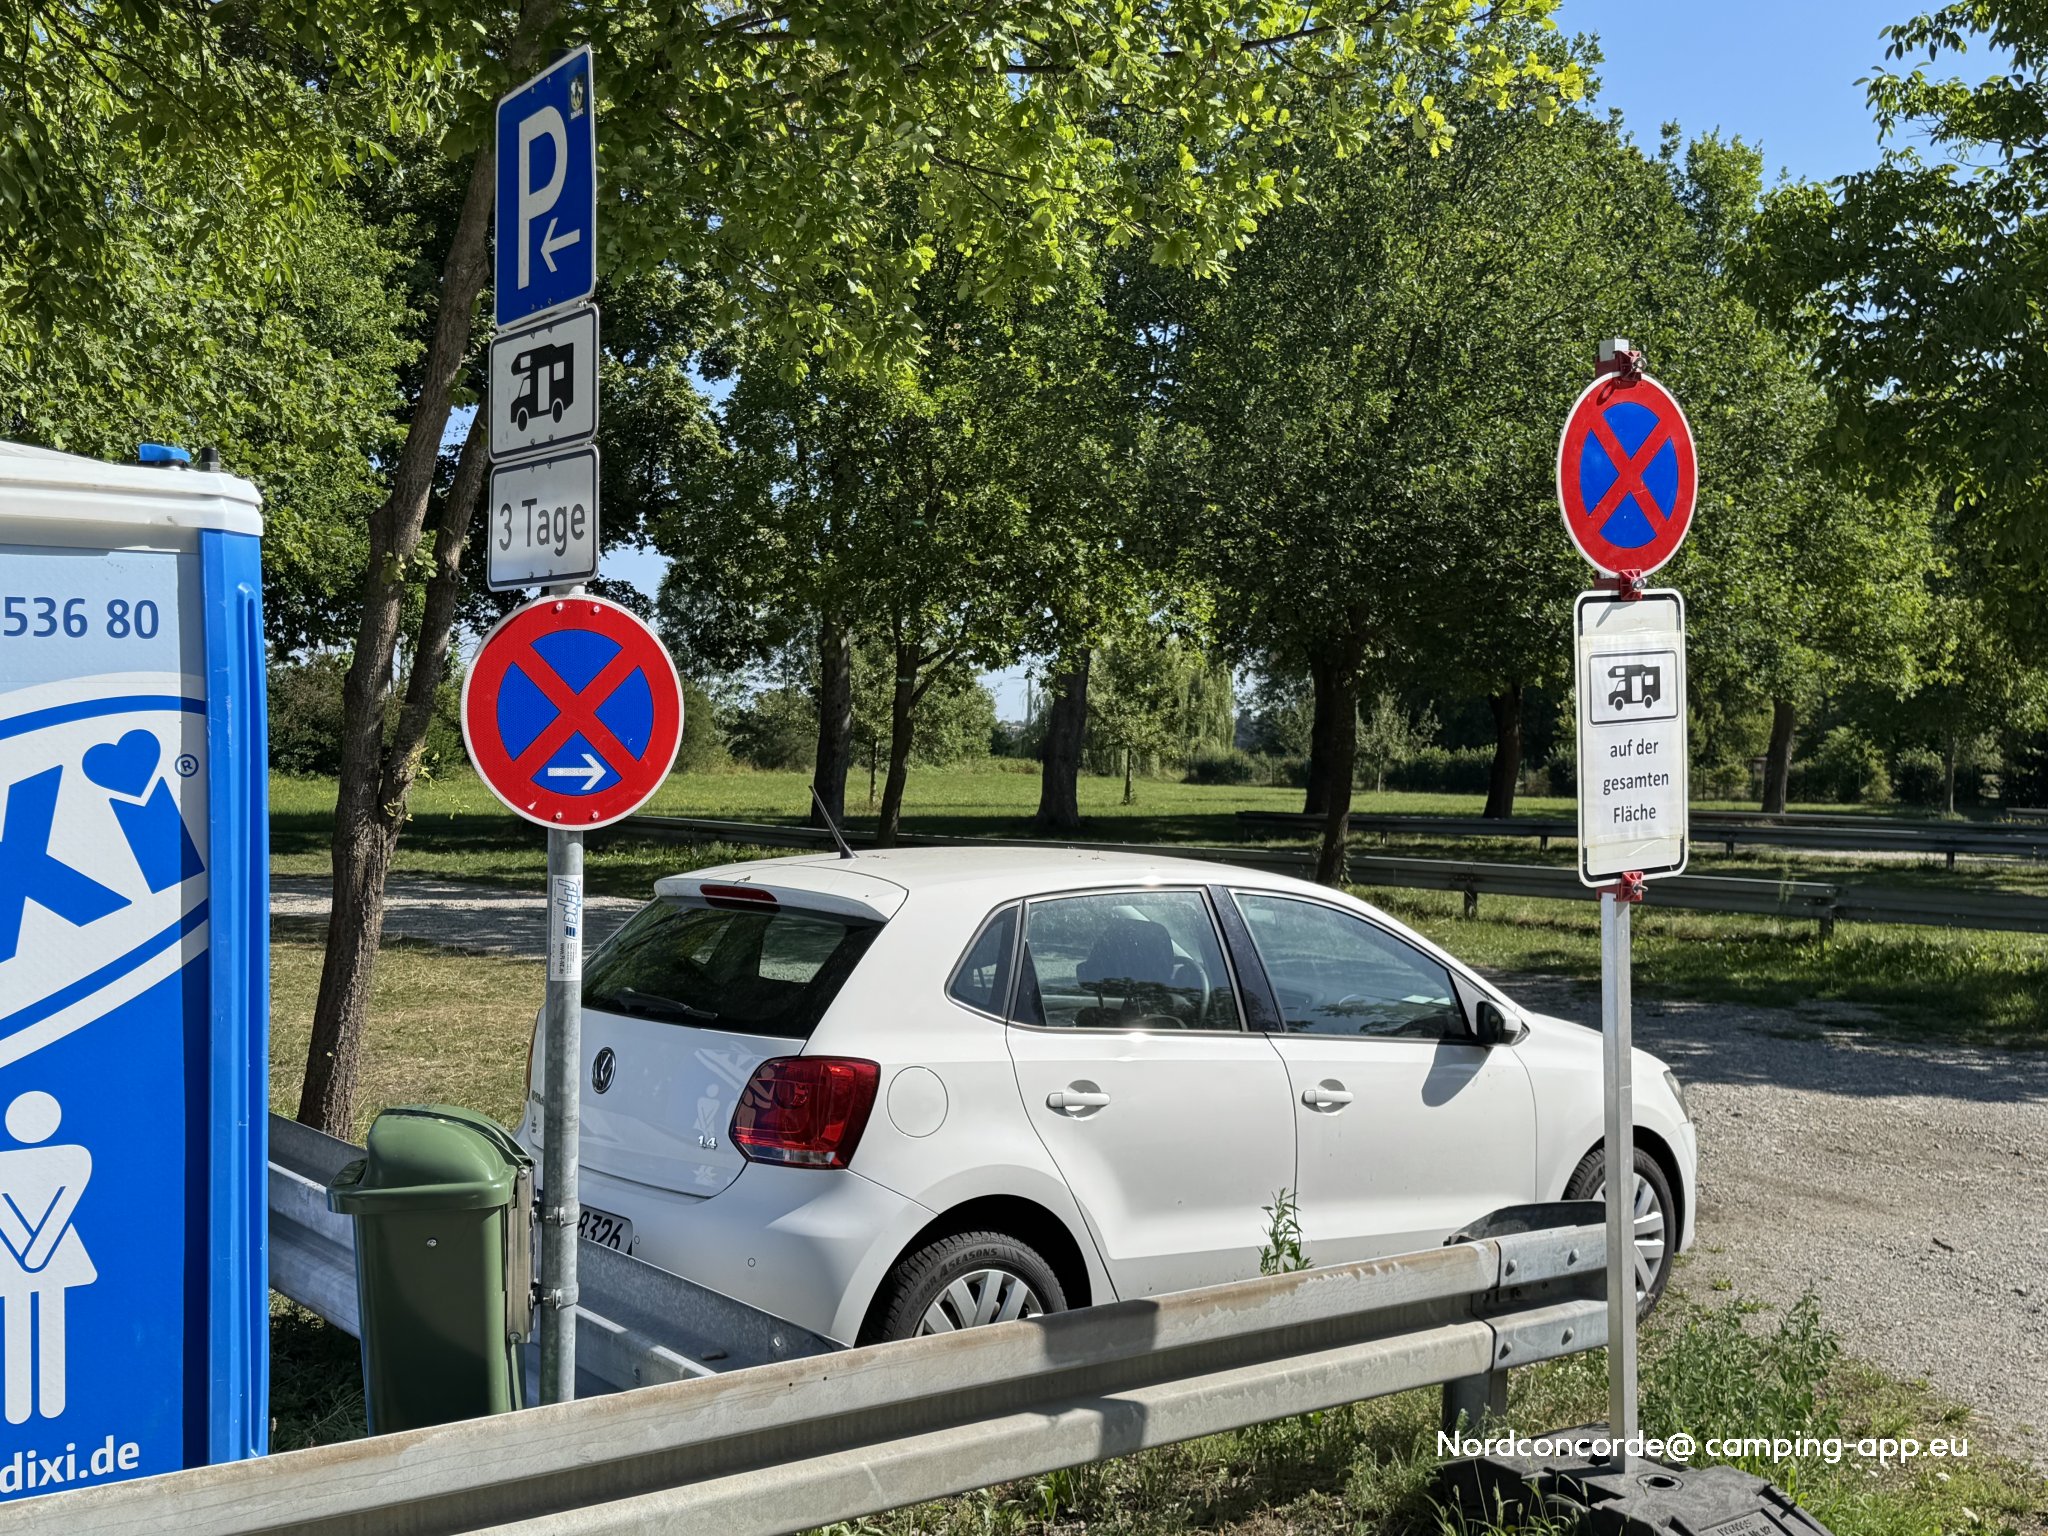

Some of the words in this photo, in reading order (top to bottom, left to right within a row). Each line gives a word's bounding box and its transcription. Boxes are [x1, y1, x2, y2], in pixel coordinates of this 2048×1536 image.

[517, 105, 568, 290] P
[499, 502, 513, 552] 3
[521, 497, 586, 558] Tage
[3, 596, 88, 638] 536
[106, 598, 160, 640] 80
[1610, 739, 1633, 758] auf
[1636, 738, 1659, 755] der
[1603, 772, 1669, 796] gesamten
[1613, 804, 1657, 824] Fläche
[0, 1435, 141, 1494] dixi.de
